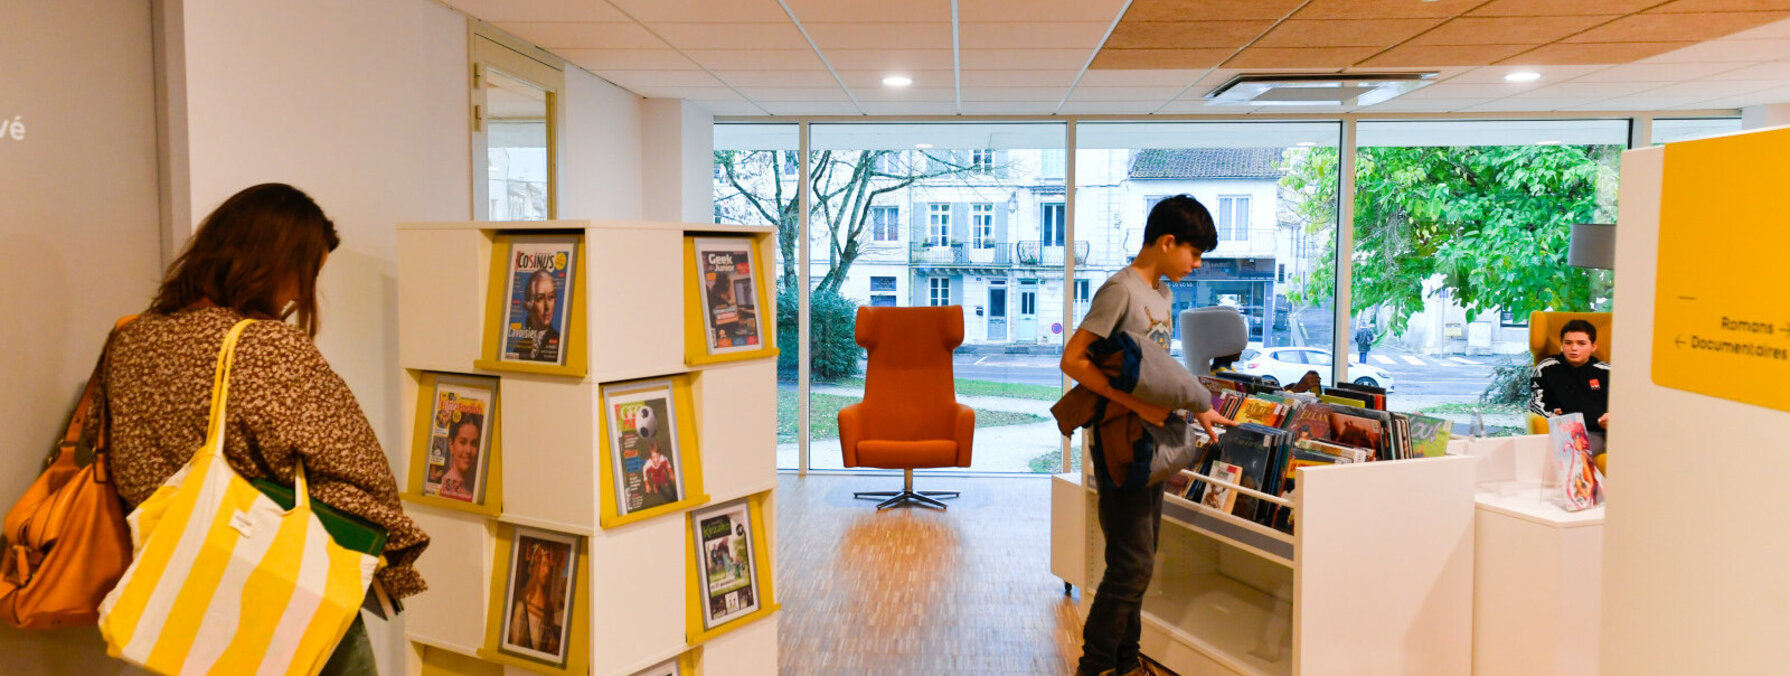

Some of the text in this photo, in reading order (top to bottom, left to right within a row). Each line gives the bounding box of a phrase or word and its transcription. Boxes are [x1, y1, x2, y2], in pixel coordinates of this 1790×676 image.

[708, 254, 733, 265] Geek
[715, 263, 735, 272] Junior
[1721, 316, 1774, 335] Romans
[1691, 335, 1788, 360] Documentaires
